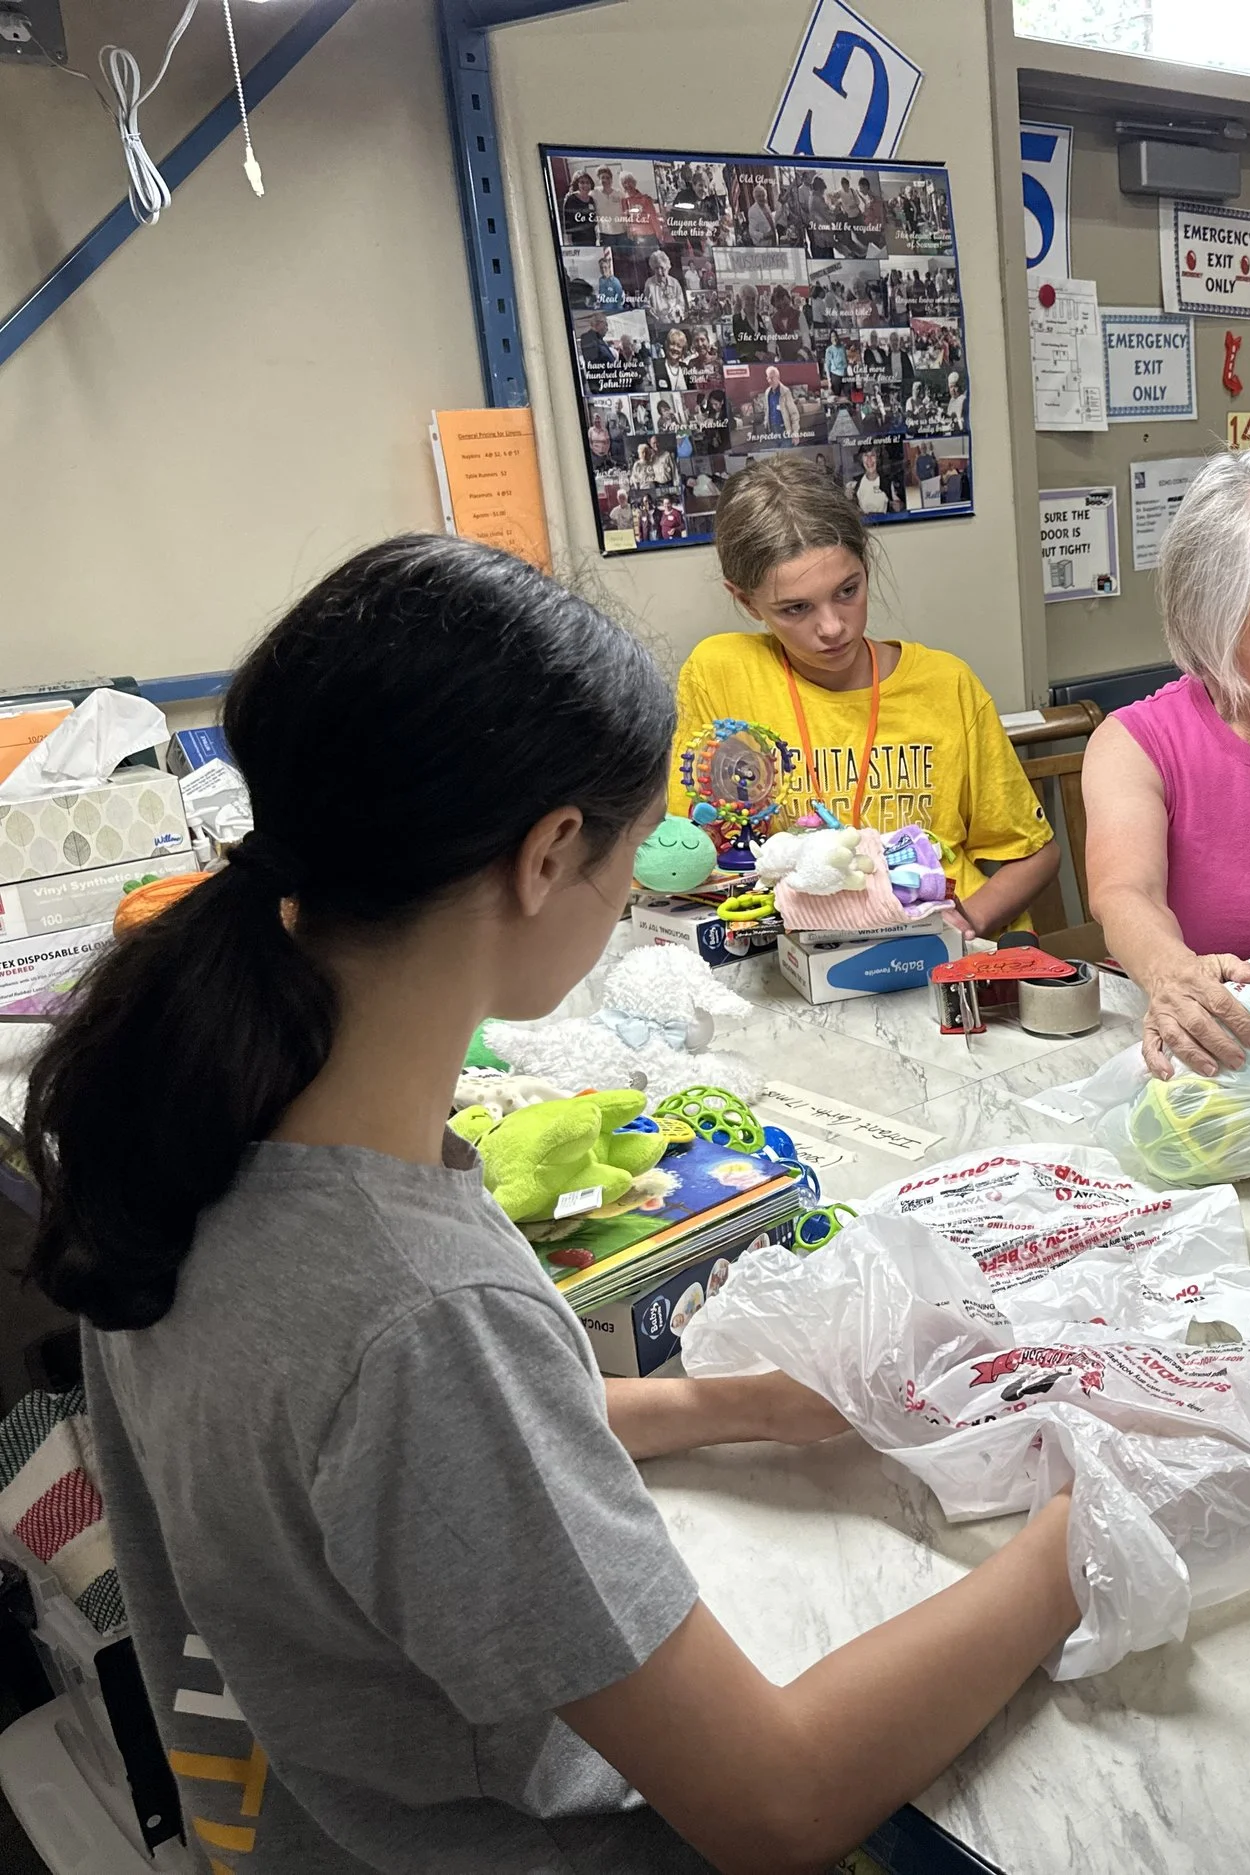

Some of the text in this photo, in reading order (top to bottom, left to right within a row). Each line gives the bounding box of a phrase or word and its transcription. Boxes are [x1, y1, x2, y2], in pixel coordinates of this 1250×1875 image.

[667, 217, 697, 231] Anyone
[1207, 252, 1234, 269] EXIT
[1205, 277, 1237, 294] ONLY
[737, 332, 752, 341] The
[1107, 332, 1187, 349] EMERGENCY
[587, 360, 605, 369] have
[607, 359, 621, 369] told
[1134, 360, 1163, 376] EXIT
[585, 370, 617, 380] hundred
[1132, 386, 1167, 401] ONLY
[746, 431, 782, 443] Inspector
[1044, 509, 1091, 523] SURE THE
[1041, 527, 1081, 541] DOOR IS
[1059, 543, 1091, 556] TIGHT!
[868, 744, 934, 791] STATE
[33, 883, 68, 900] Vinyl
[70, 871, 131, 893] Synthetic
[40, 913, 63, 928] 100
[17, 946, 79, 967] DISPOSABLE
[894, 959, 924, 973] Baby
[855, 1122, 922, 1149] Infant
[650, 1302, 660, 1334] Baby
